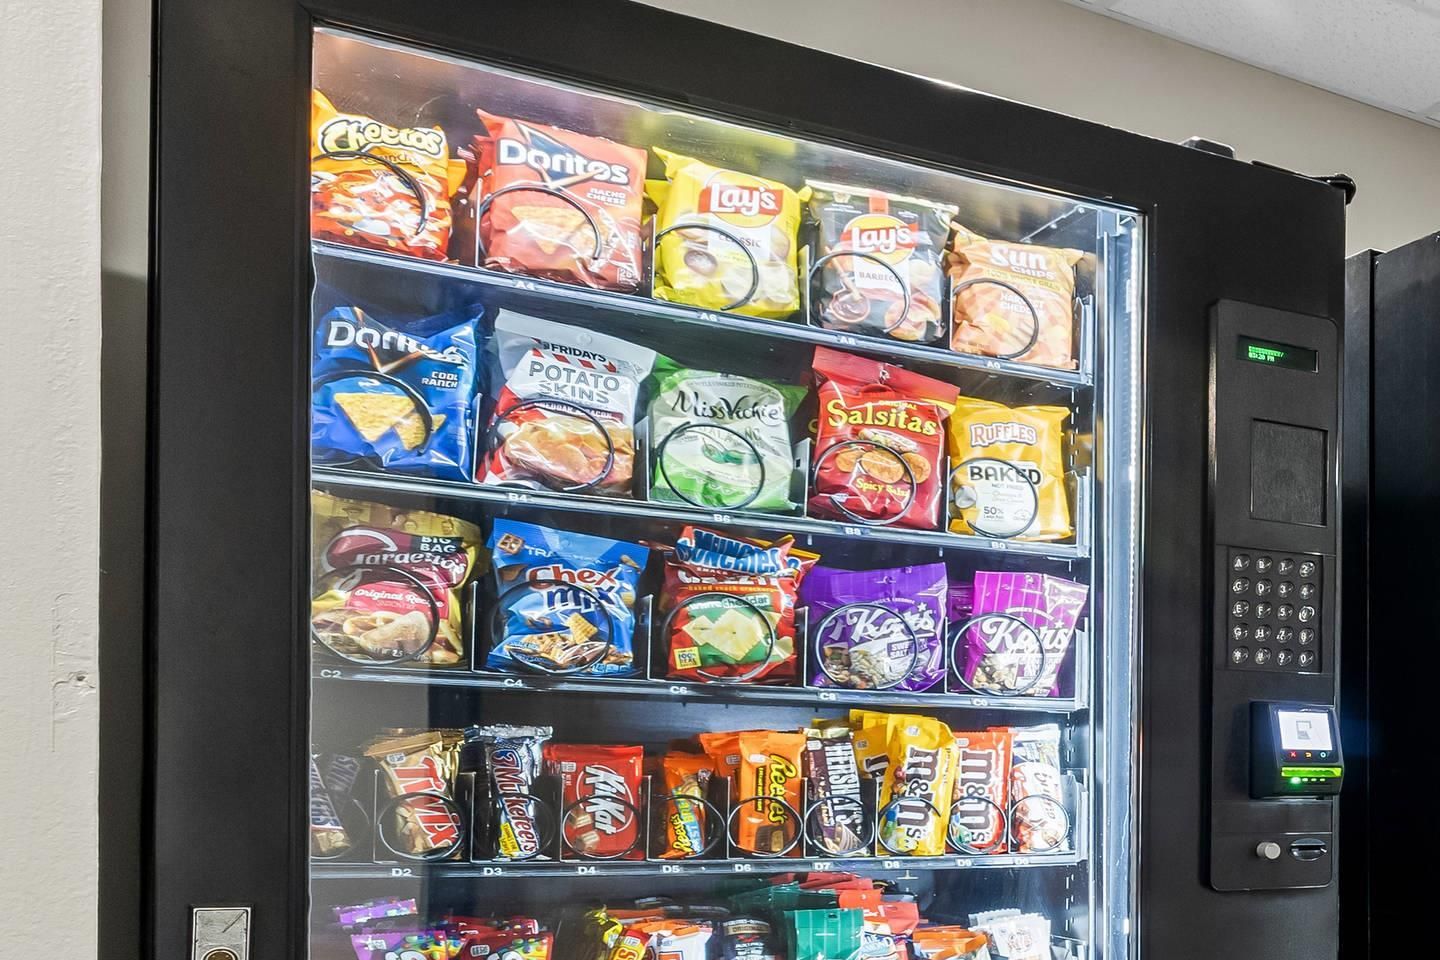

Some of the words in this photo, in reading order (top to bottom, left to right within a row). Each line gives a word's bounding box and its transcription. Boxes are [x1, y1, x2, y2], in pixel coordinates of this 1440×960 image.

[320, 119, 444, 156] Cheetos
[498, 138, 630, 185] Doritos
[710, 183, 779, 217] Lay's
[719, 233, 761, 249] CLSSIC
[852, 224, 913, 254] Lay's
[991, 244, 1048, 271] Sun
[515, 280, 536, 290] A4
[700, 313, 718, 322] A6
[840, 336, 857, 346] A8
[431, 371, 459, 381] COOL
[529, 360, 620, 391] POTATO
[421, 378, 459, 388] RANCH
[538, 380, 610, 404] SKINS
[826, 399, 938, 436] Salsitas
[971, 423, 1037, 447] RUFFLES
[969, 465, 1042, 486] BAKED
[856, 477, 884, 493] Spicy
[508, 493, 528, 502] B4
[714, 514, 731, 523] B6
[845, 527, 861, 536] B8
[420, 543, 457, 553] BAG
[526, 563, 619, 592] Chex
[354, 588, 403, 601] Original
[405, 591, 444, 609] Rece
[721, 594, 769, 609] chedar
[320, 669, 342, 679] C2
[503, 679, 524, 687] C4
[670, 686, 688, 695] C6
[767, 753, 798, 824] Reese's
[824, 742, 863, 827] HERSHEY'S
[662, 865, 681, 874] D5
[734, 863, 752, 872] D6
[814, 862, 831, 870] D7
[884, 861, 900, 869] D8
[391, 868, 412, 877] D2
[483, 867, 502, 876] D3
[577, 866, 596, 875] D4
